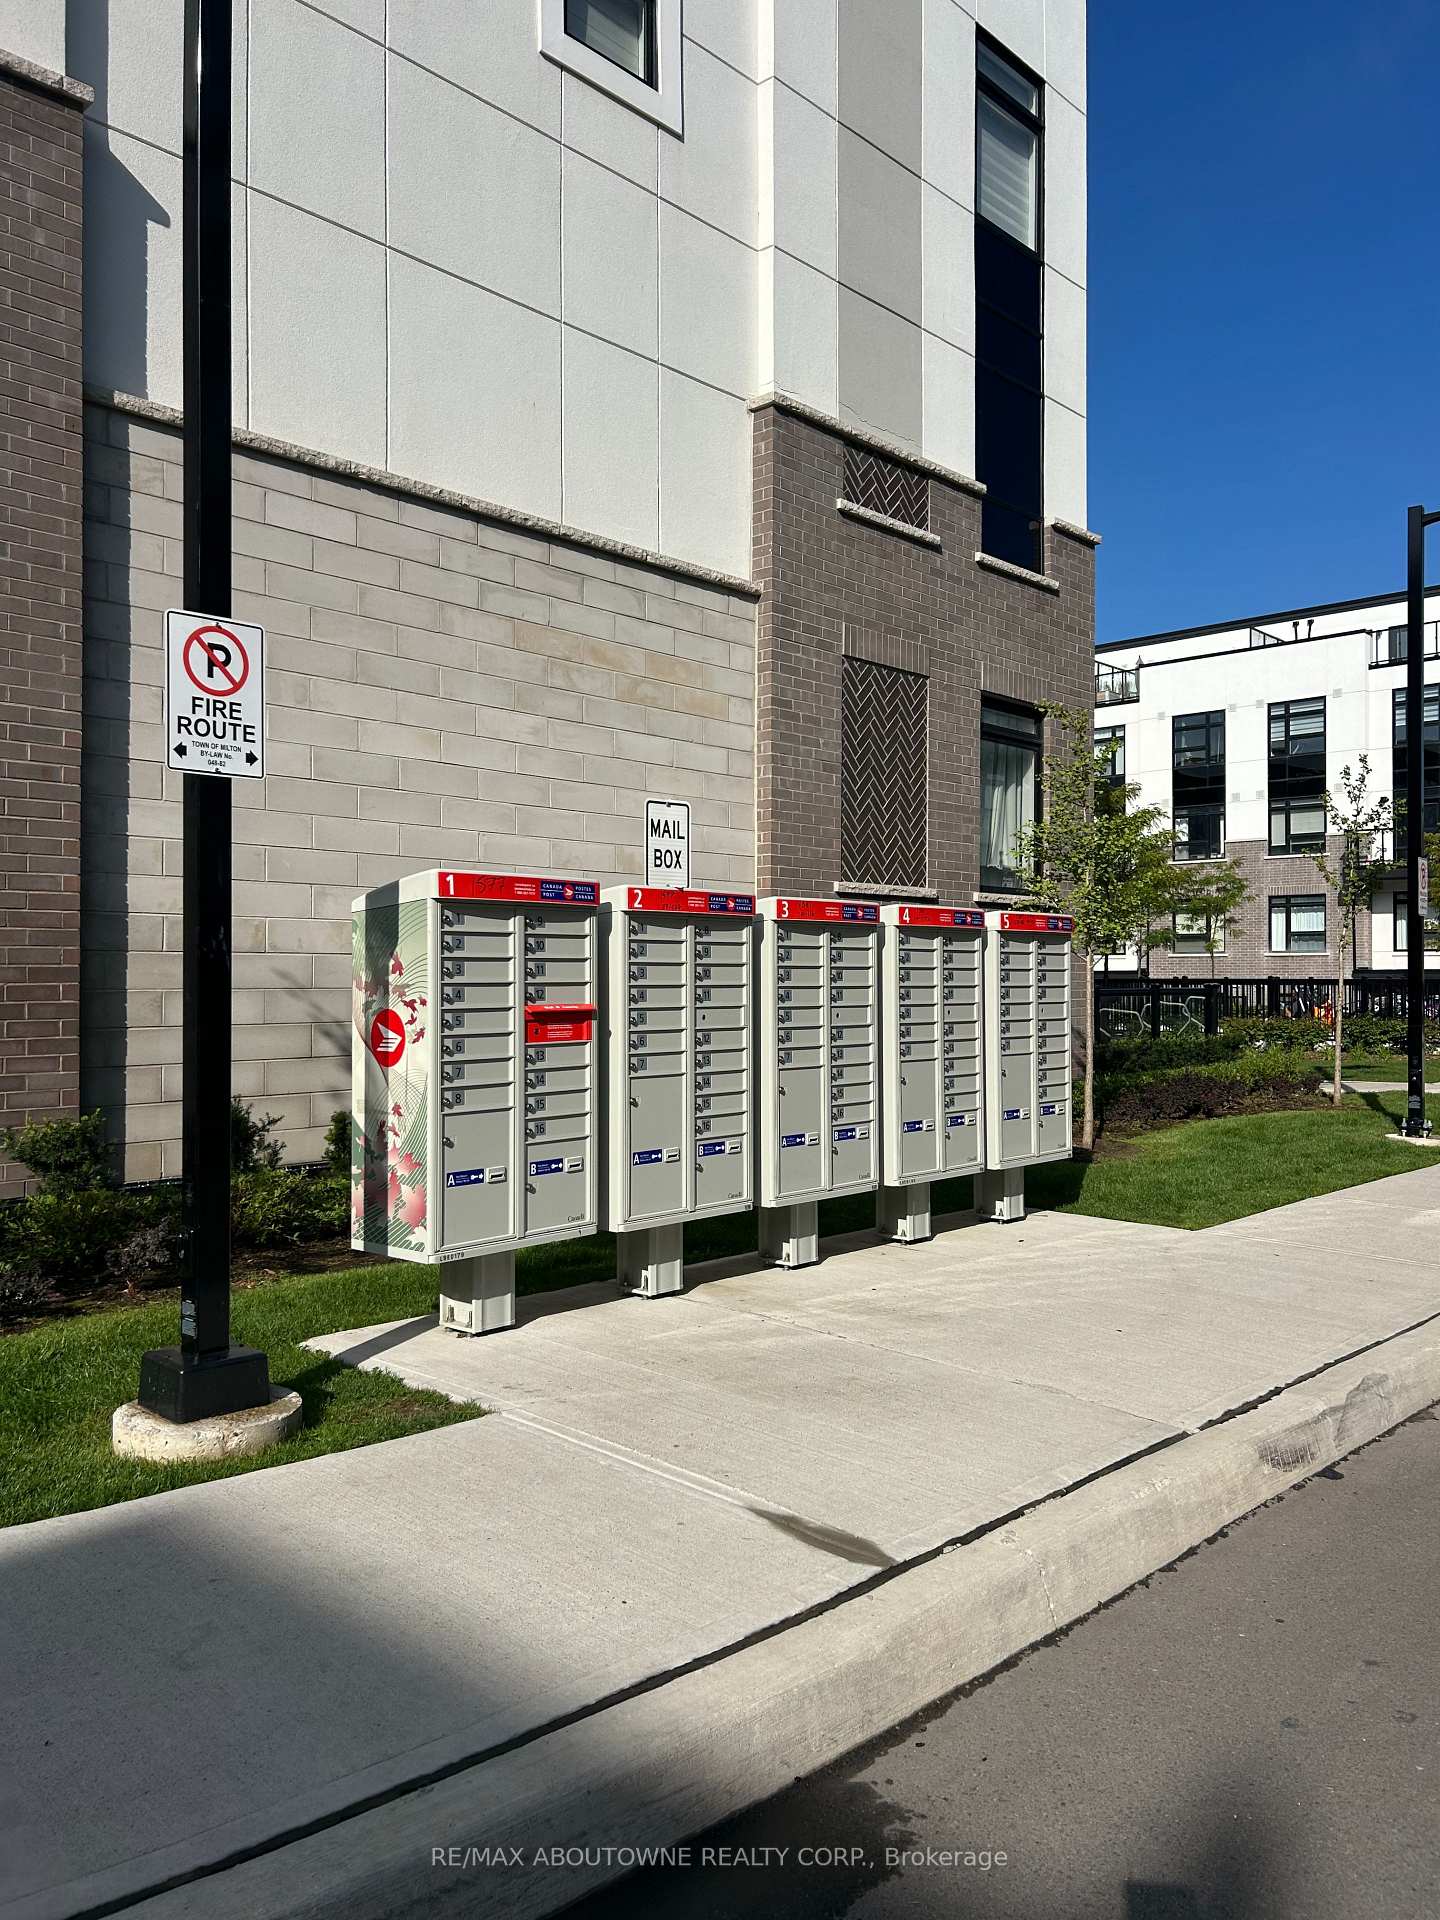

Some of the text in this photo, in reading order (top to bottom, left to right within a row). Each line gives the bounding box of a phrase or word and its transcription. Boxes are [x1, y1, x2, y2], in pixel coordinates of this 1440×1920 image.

[192, 696, 242, 720] FIRE
[178, 716, 256, 743] ROUTE
[221, 744, 241, 752] MILTON
[200, 750, 223, 758] BY-LAW
[650, 818, 685, 840] MAIL
[654, 848, 682, 869] BOX
[445, 874, 454, 896] 1
[633, 890, 642, 907] 2
[781, 901, 789, 917] 3
[537, 916, 543, 926] 9
[903, 908, 910, 924] 4
[1004, 915, 1009, 928] 5
[455, 938, 462, 949] 2
[536, 940, 544, 951] 10
[639, 946, 645, 954] 2
[704, 947, 708, 956] 9
[455, 964, 462, 974] 3
[536, 965, 544, 975] 11
[639, 968, 645, 978] 3
[455, 990, 462, 1000] 4
[703, 991, 710, 1000] 11
[455, 1016, 462, 1026] 5
[640, 1014, 644, 1023] 5
[639, 1036, 644, 1046] 6
[455, 1042, 462, 1052] 6
[536, 1050, 544, 1061] 13
[639, 1059, 644, 1068] 7
[455, 1068, 461, 1077] 7
[536, 1074, 544, 1085] 14
[455, 1094, 462, 1104] 8
[536, 1099, 544, 1109] 15
[703, 1099, 710, 1108] 15
[536, 1124, 544, 1134] 16
[703, 1121, 710, 1130] 16
[904, 1124, 908, 1132] A
[835, 1132, 838, 1140] B
[783, 1138, 787, 1146] A
[699, 1146, 704, 1155] B
[634, 1154, 640, 1164] A
[531, 1164, 536, 1175] B
[448, 1174, 455, 1186] A
